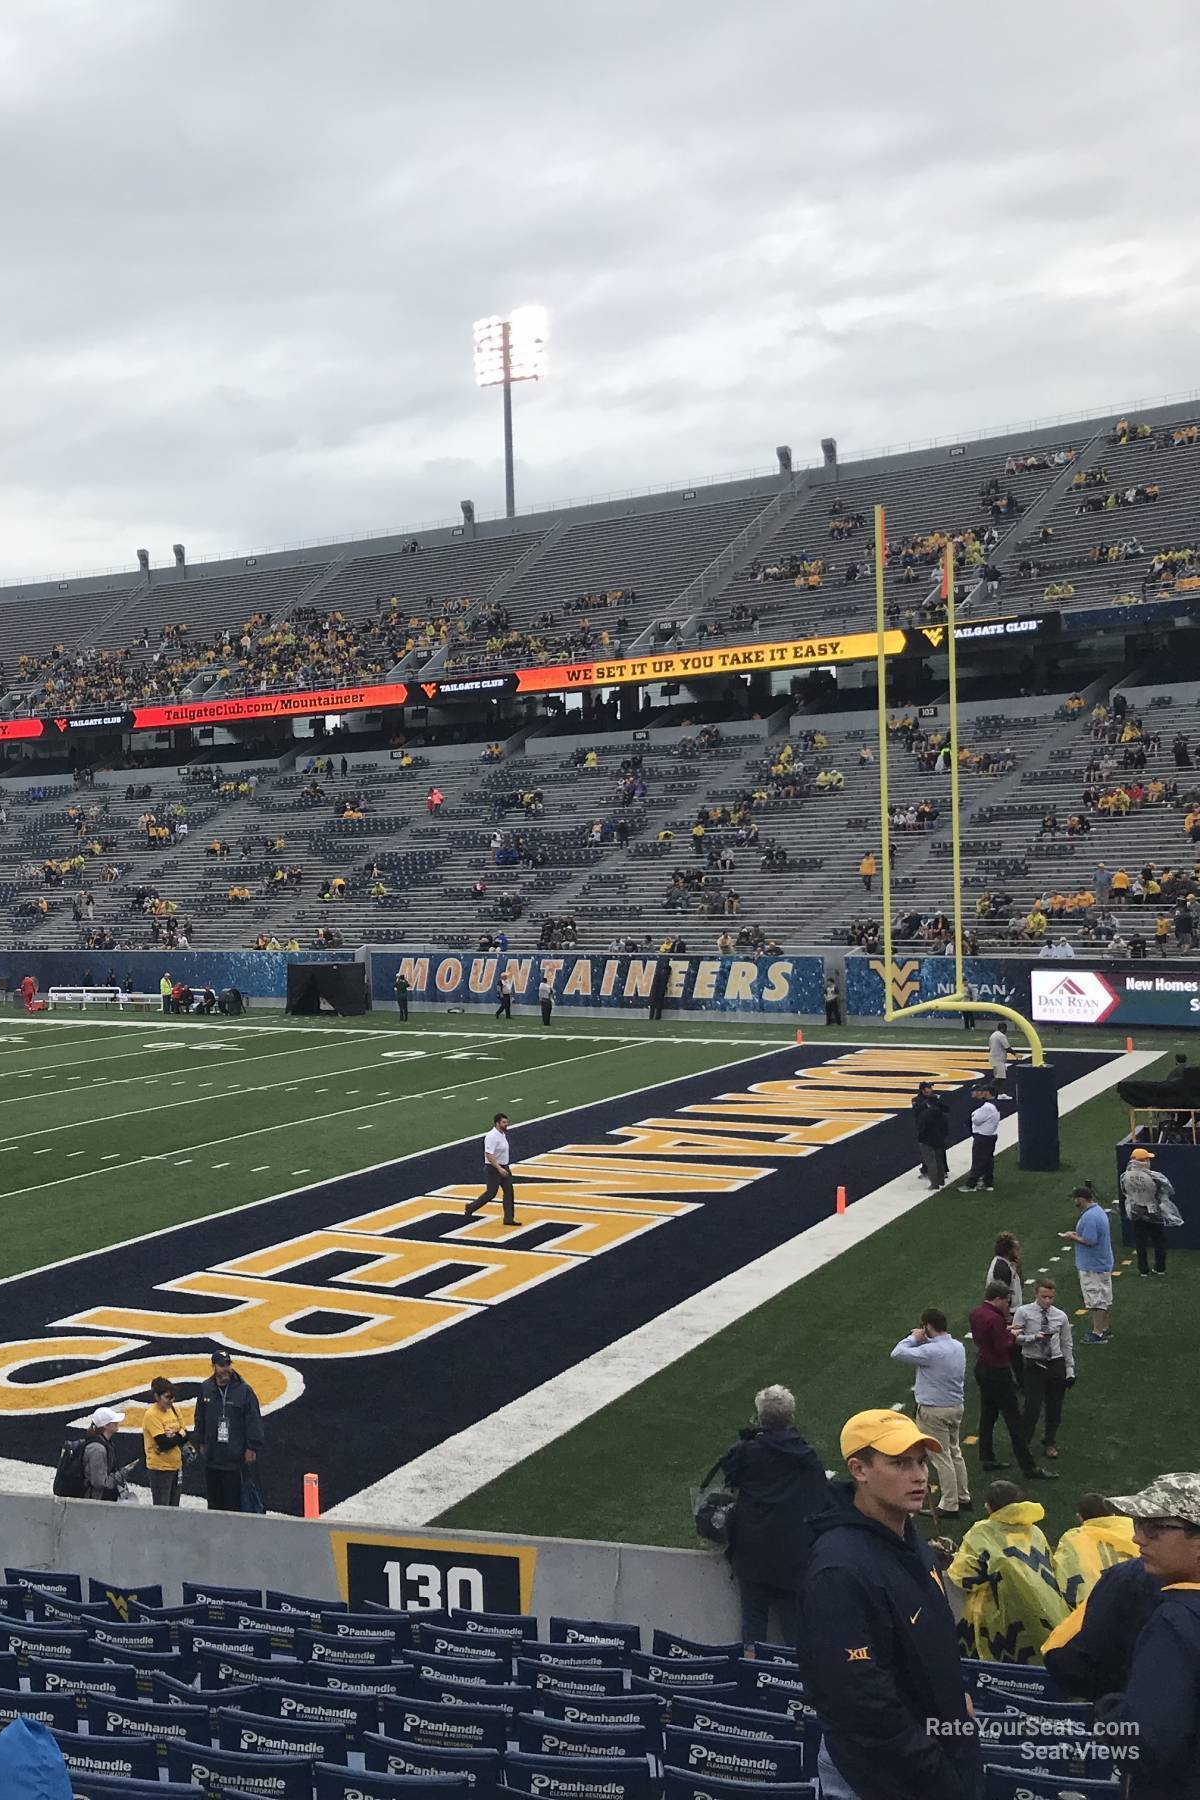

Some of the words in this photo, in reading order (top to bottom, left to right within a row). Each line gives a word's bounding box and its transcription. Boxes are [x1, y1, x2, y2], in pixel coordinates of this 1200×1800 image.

[1005, 621, 1037, 633] CLUB
[566, 669, 592, 682] WE
[596, 666, 625, 679] SET
[630, 664, 648, 676] IT
[652, 660, 676, 674] UP.
[680, 656, 714, 671] YOU
[719, 651, 765, 666] TAKE
[768, 647, 788, 661] IT
[792, 642, 844, 659] EASY.
[440, 682, 480, 692] TAILGATE
[481, 679, 504, 688] CLUB
[164, 692, 365, 721] TailgateClub.com/Mountaineer
[922, 708, 935, 716] 103
[69, 717, 101, 728] TAILGATE
[102, 716, 121, 725] CLUB
[1126, 977, 1153, 990] New
[1155, 977, 1198, 992] Homes
[27, 1582, 67, 1592] Panhandle
[383, 1560, 484, 1616] 130
[250, 1621, 294, 1634] Panhandle
[348, 1629, 395, 1637] Panhandle
[478, 1625, 522, 1635] Panhandle
[106, 1636, 153, 1645] Panhandle
[22, 1641, 71, 1654] Panhandle
[447, 1644, 496, 1658] Panhandle
[845, 1646, 872, 1662] XII
[324, 1649, 375, 1660] Panhandle
[552, 1658, 602, 1666] Panhandle
[432, 1670, 486, 1684] Panhandle
[662, 1672, 714, 1680] Panhandle
[59, 1680, 116, 1692] Panhandle
[340, 1682, 396, 1692] Panhandle
[550, 1679, 606, 1692] Panhandle
[991, 1678, 1044, 1692] Panhandle
[296, 1702, 357, 1719] Panhandle
[580, 1712, 640, 1723] Panhandle
[122, 1719, 186, 1736] Panhandle
[420, 1720, 484, 1735] Panhandle
[710, 1722, 774, 1740] Panhandle
[258, 1736, 324, 1752] Panhandle
[559, 1740, 625, 1756] Panhandle
[708, 1752, 778, 1770] Panhandle
[210, 1772, 286, 1788] Panhandle
[550, 1784, 624, 1794] Panhandle
